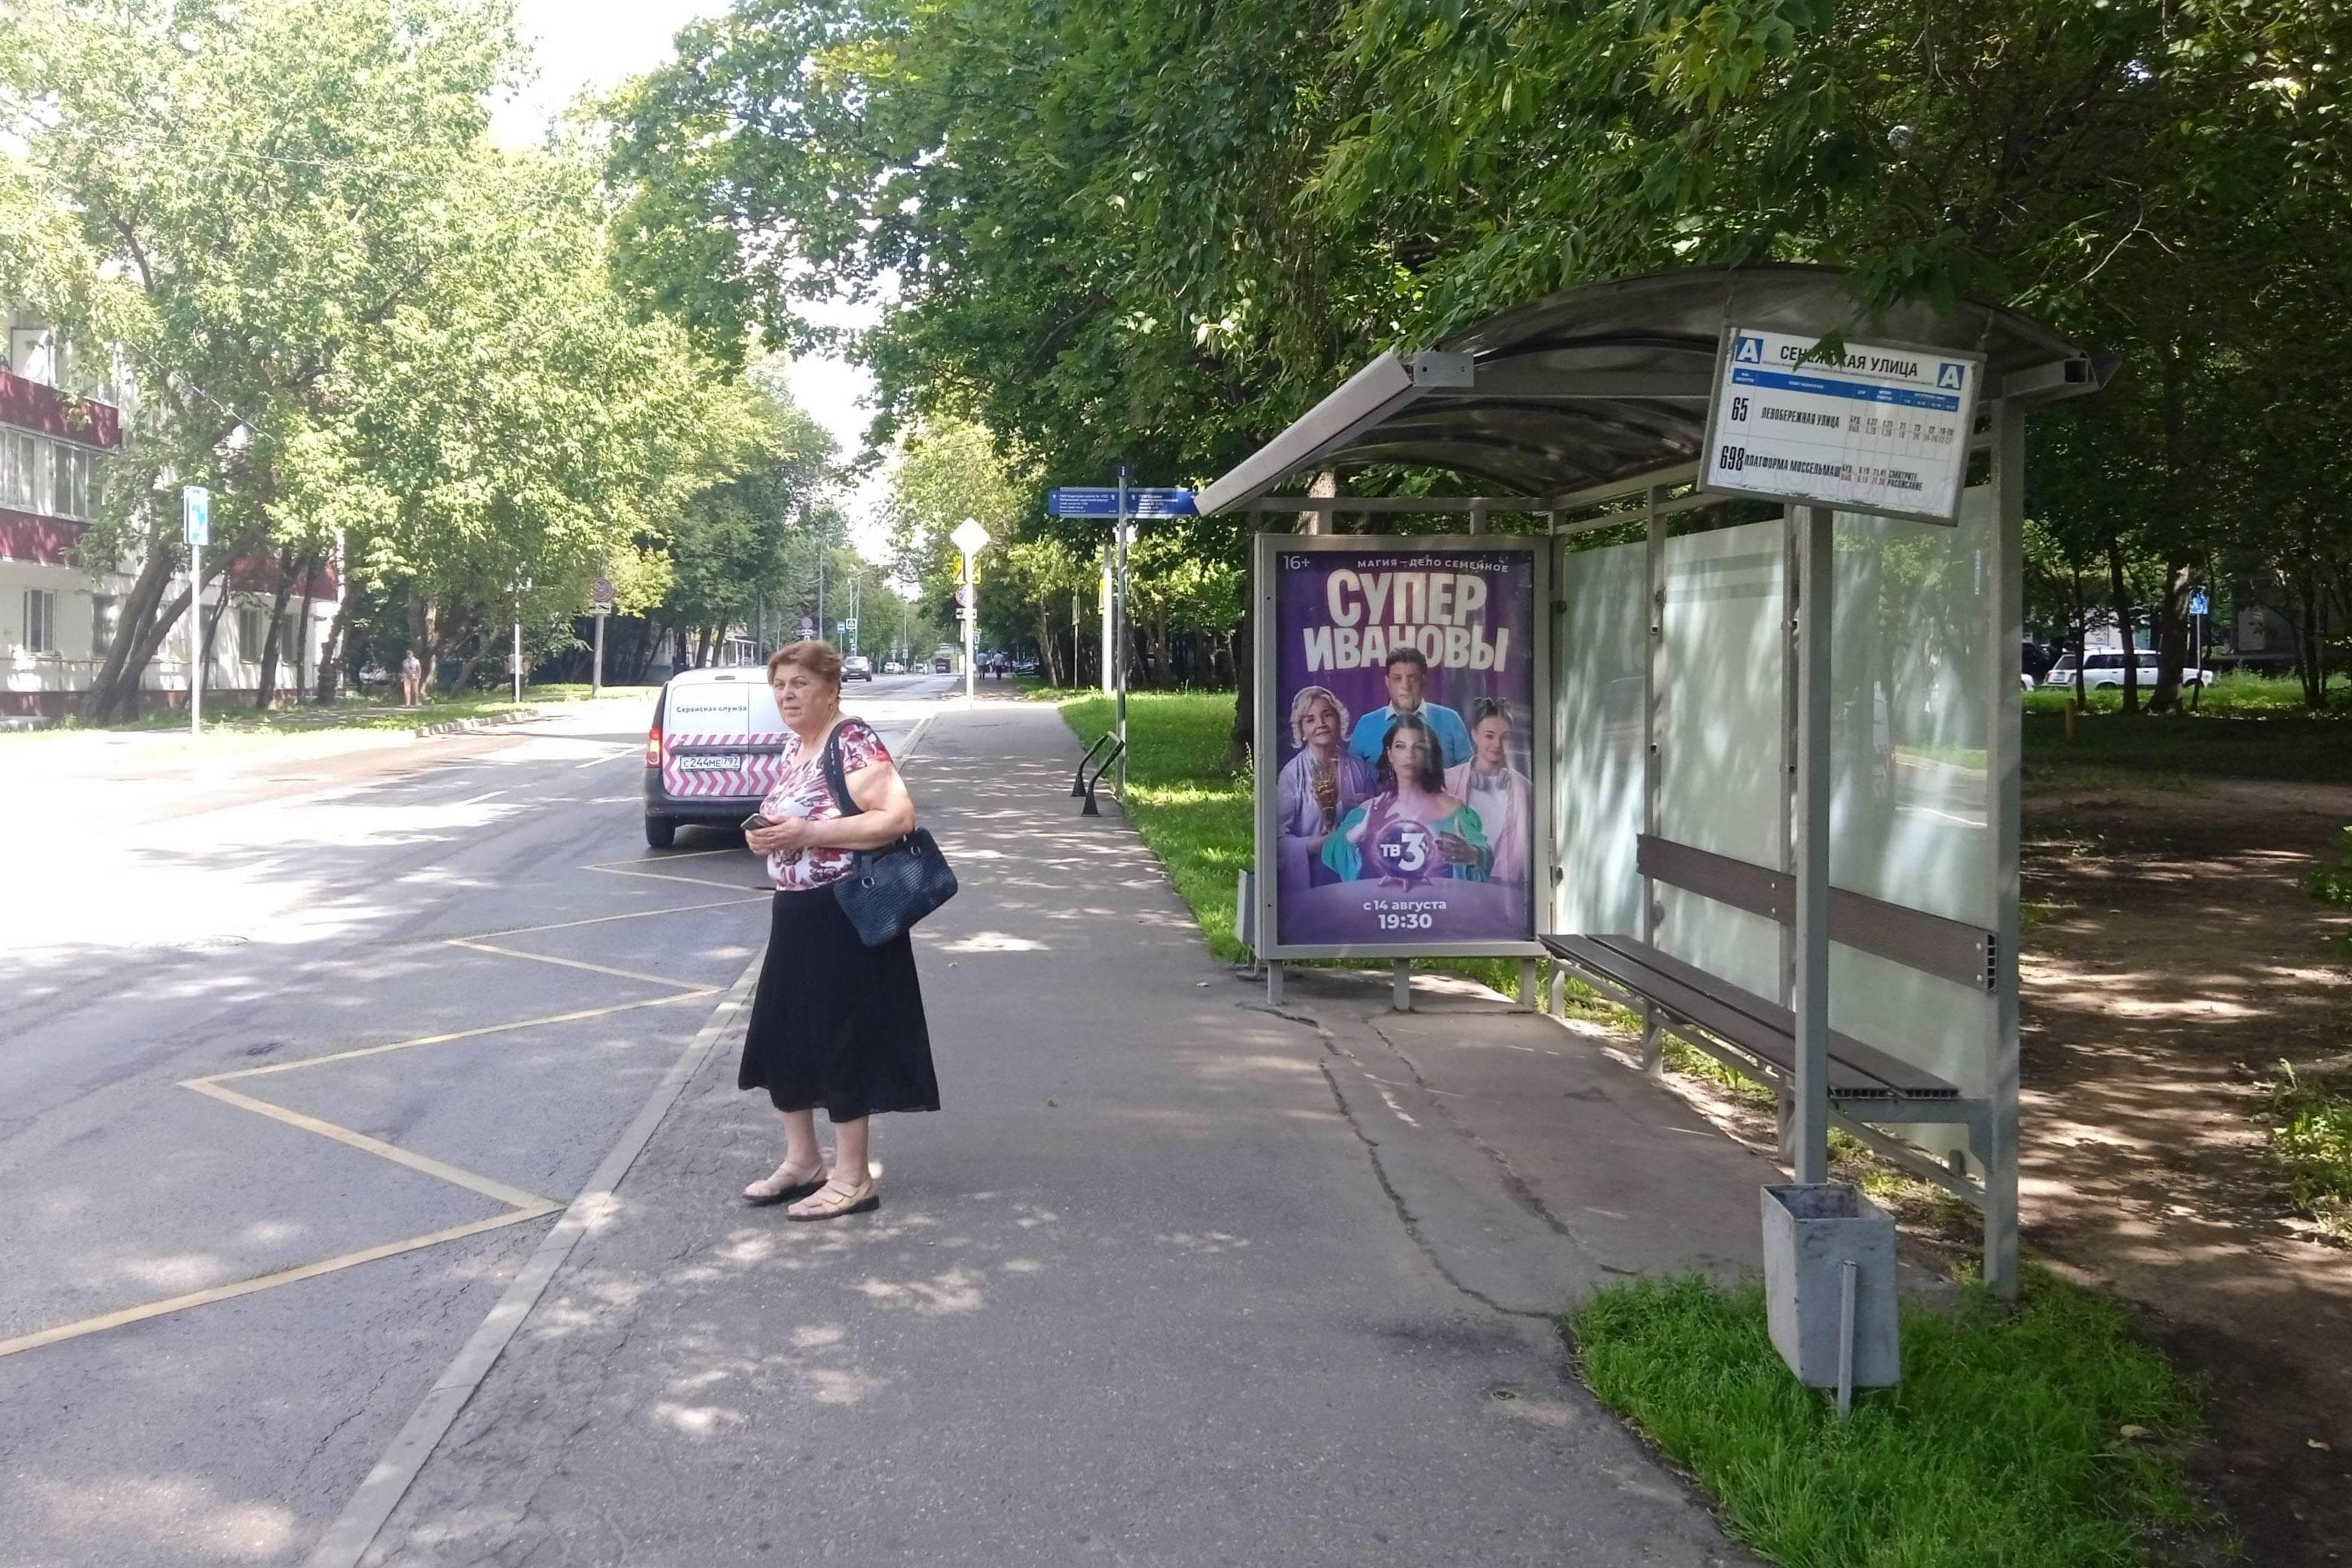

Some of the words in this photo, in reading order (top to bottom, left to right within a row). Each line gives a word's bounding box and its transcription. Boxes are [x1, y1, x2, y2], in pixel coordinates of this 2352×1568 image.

[1871, 356, 1918, 378] УЛИЦА
[1732, 397, 1749, 421] 65
[1761, 407, 1816, 424] ЛЕВОБЕРЕЖНАЯ
[1816, 414, 1840, 429] УЛИЦА
[1720, 446, 1745, 470] 698
[1744, 454, 1789, 470] ПЛАТФОРМА
[1790, 460, 1841, 477] МОССЕЛЬМАШ
[1283, 556, 1311, 570] 16+
[1358, 559, 1397, 568] МАГИЯ
[1409, 559, 1442, 568] ДЕЛО
[1444, 560, 1508, 573] СЕМЕЙНОЕ
[1327, 568, 1487, 626] СУПЕР
[1303, 625, 1509, 672] ИВАНОВЫ
[1363, 902, 1371, 911] с
[1373, 900, 1389, 911] 14
[1392, 901, 1447, 912] августа
[1378, 913, 1432, 929] 19:30
